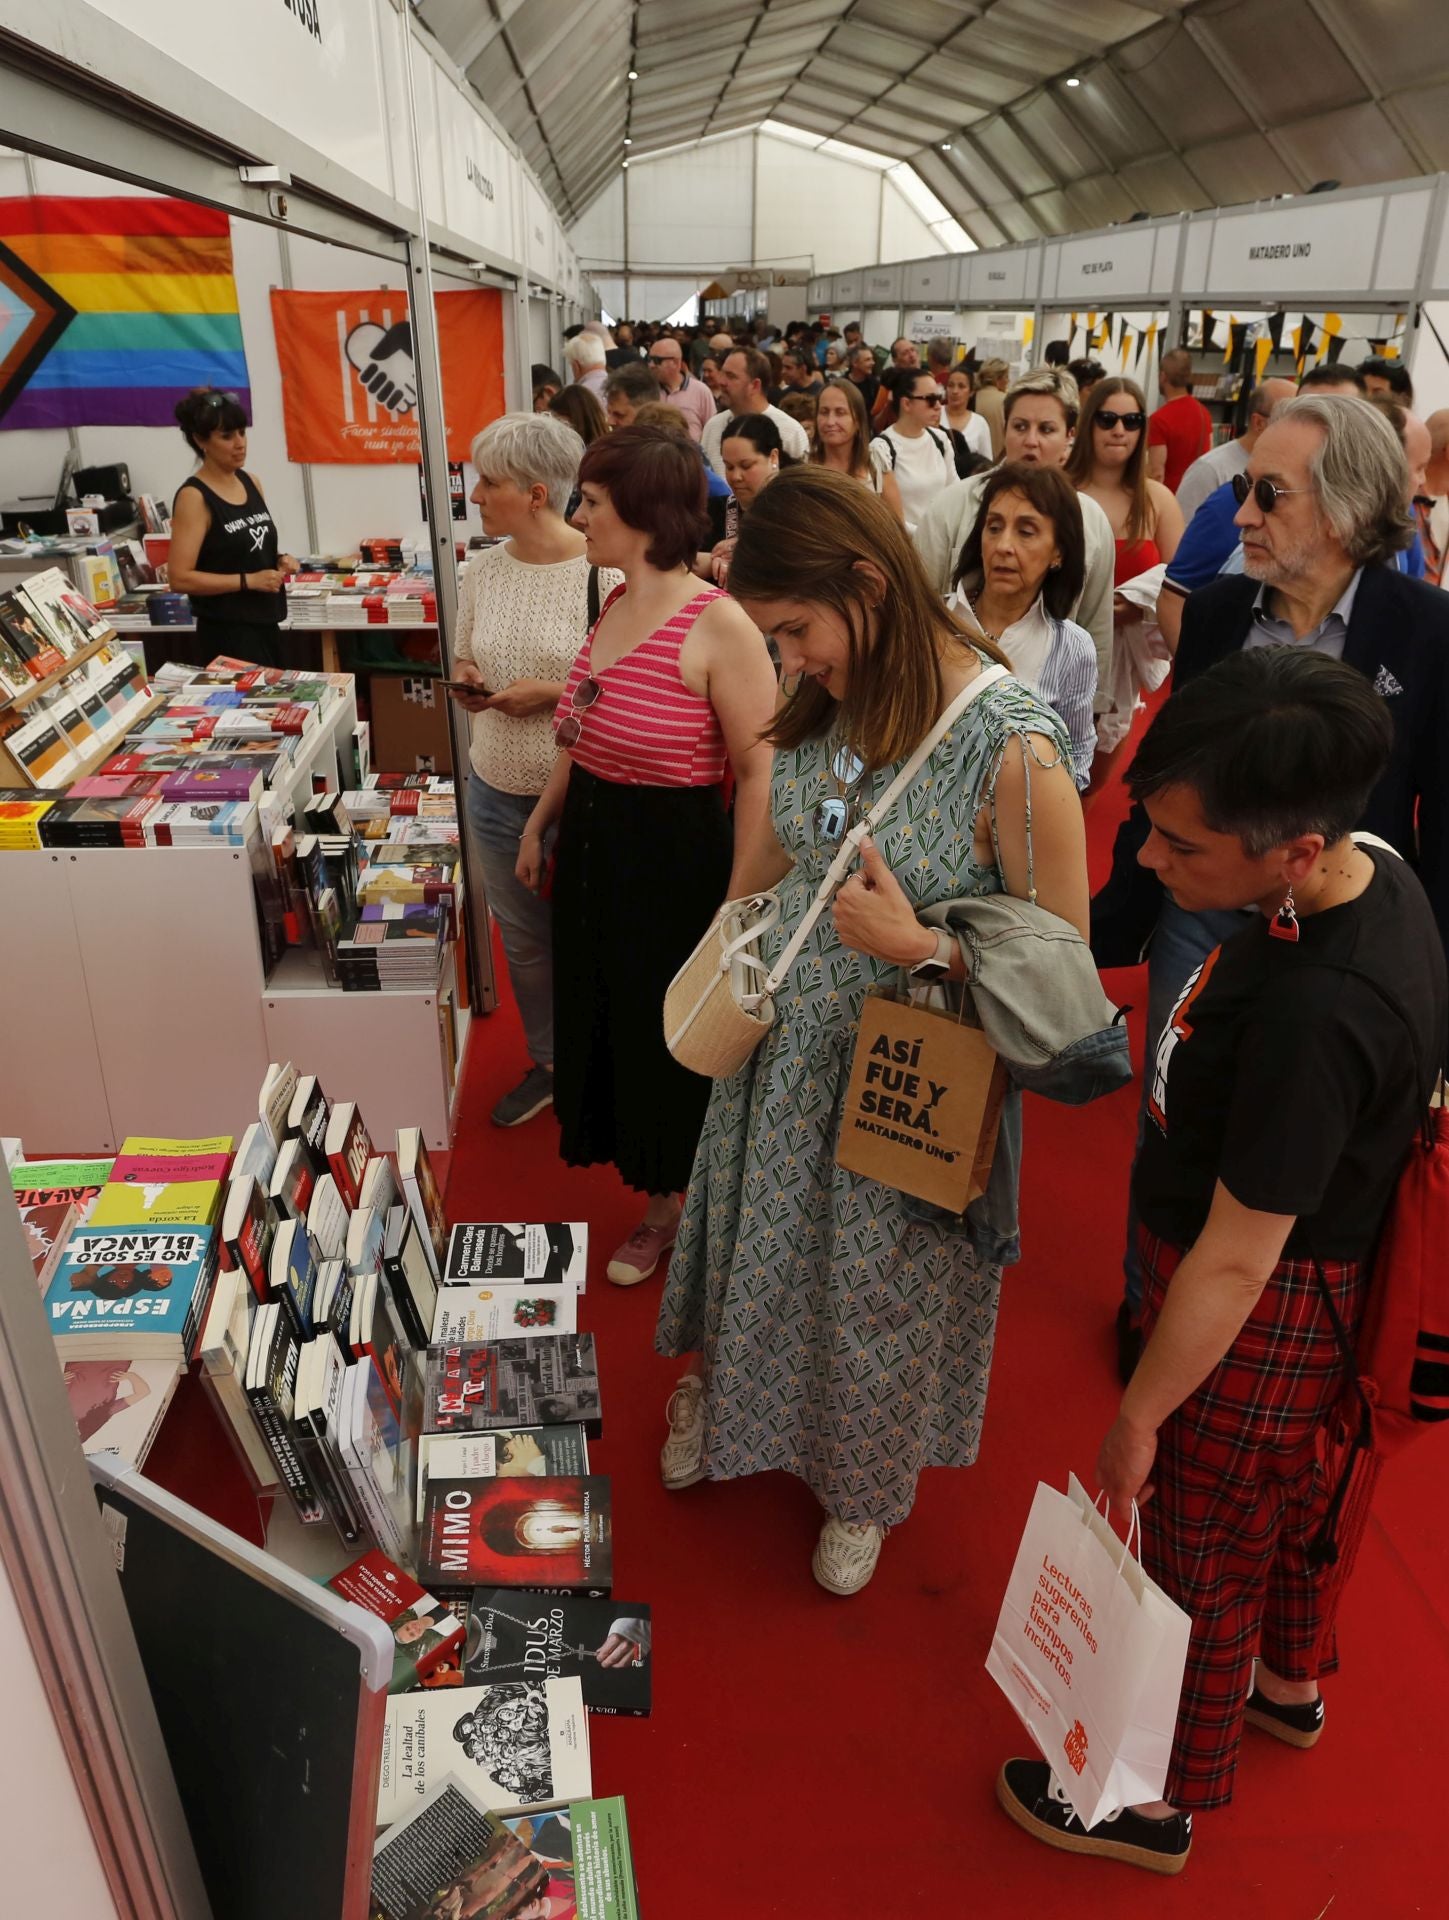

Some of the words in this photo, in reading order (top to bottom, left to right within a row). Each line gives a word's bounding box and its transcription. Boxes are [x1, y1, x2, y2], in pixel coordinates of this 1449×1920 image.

[1249, 245, 1291, 260] MATADERO
[1292, 243, 1311, 257] UNO
[869, 1034, 924, 1068] ASÍ
[865, 1061, 921, 1099] FUE
[927, 1080, 948, 1107] Y
[859, 1090, 940, 1138] SERÁ.
[854, 1118, 924, 1150] MATADERO
[149, 1215, 180, 1224] xorda
[183, 1215, 198, 1224] La
[83, 1236, 195, 1252] BLANCA
[462, 1226, 475, 1244] Clara
[76, 1250, 129, 1263] SOLO
[133, 1250, 157, 1262] ES
[161, 1250, 190, 1262] NO
[457, 1243, 472, 1277] Carmen
[470, 1229, 486, 1272] Balmaseda
[494, 1255, 502, 1267] los
[485, 1255, 493, 1274] Donde
[52, 1299, 171, 1320] ESPAÑA
[440, 1310, 450, 1335] malestar
[449, 1326, 457, 1334] las
[455, 1316, 467, 1343] iudades
[465, 1325, 475, 1342] orge
[268, 1355, 277, 1388] RAFAEL
[275, 1320, 285, 1350] MASSA
[261, 1418, 272, 1437] RAFAEL
[272, 1415, 283, 1437] RAFAEL
[270, 1436, 297, 1488] MIENTEN
[279, 1434, 306, 1486] MIENTEN
[472, 1447, 480, 1466] padre
[481, 1463, 490, 1474] del
[583, 1491, 591, 1526] MANTEROLA
[440, 1490, 472, 1571] MIMO
[583, 1526, 591, 1543] PEÑA
[583, 1543, 591, 1568] HÉCTOR
[1042, 1554, 1094, 1620] Lecturas
[1032, 1590, 1061, 1626] para
[1038, 1573, 1099, 1655] sugerentes
[484, 1612, 495, 1630] DÍAZ
[523, 1617, 549, 1672] IDUS
[547, 1608, 564, 1662] MARZO
[1028, 1604, 1075, 1666] tiempos
[480, 1630, 493, 1669] SECUNDINO
[1023, 1621, 1073, 1690] inciertos.
[593, 1706, 618, 1715] IDUS
[384, 1723, 392, 1737] PAZ
[415, 1709, 425, 1759] caníbales
[383, 1738, 391, 1765] TRELLES
[402, 1725, 413, 1761] lealtad
[402, 1764, 412, 1779] La
[415, 1761, 425, 1777] los
[415, 1780, 425, 1795] de
[576, 1823, 582, 1833] en
[590, 1811, 598, 1830] amor
[576, 1833, 584, 1862] adentra
[583, 1832, 592, 1855] través
[590, 1830, 598, 1840] de
[580, 1862, 585, 1872] se
[592, 1841, 601, 1870] historia
[601, 1846, 610, 1878] abuelos.
[586, 1859, 594, 1886] adulto
[579, 1873, 588, 1918] adolescente
[588, 1887, 597, 1915] mundo
[605, 1892, 612, 1902] de
